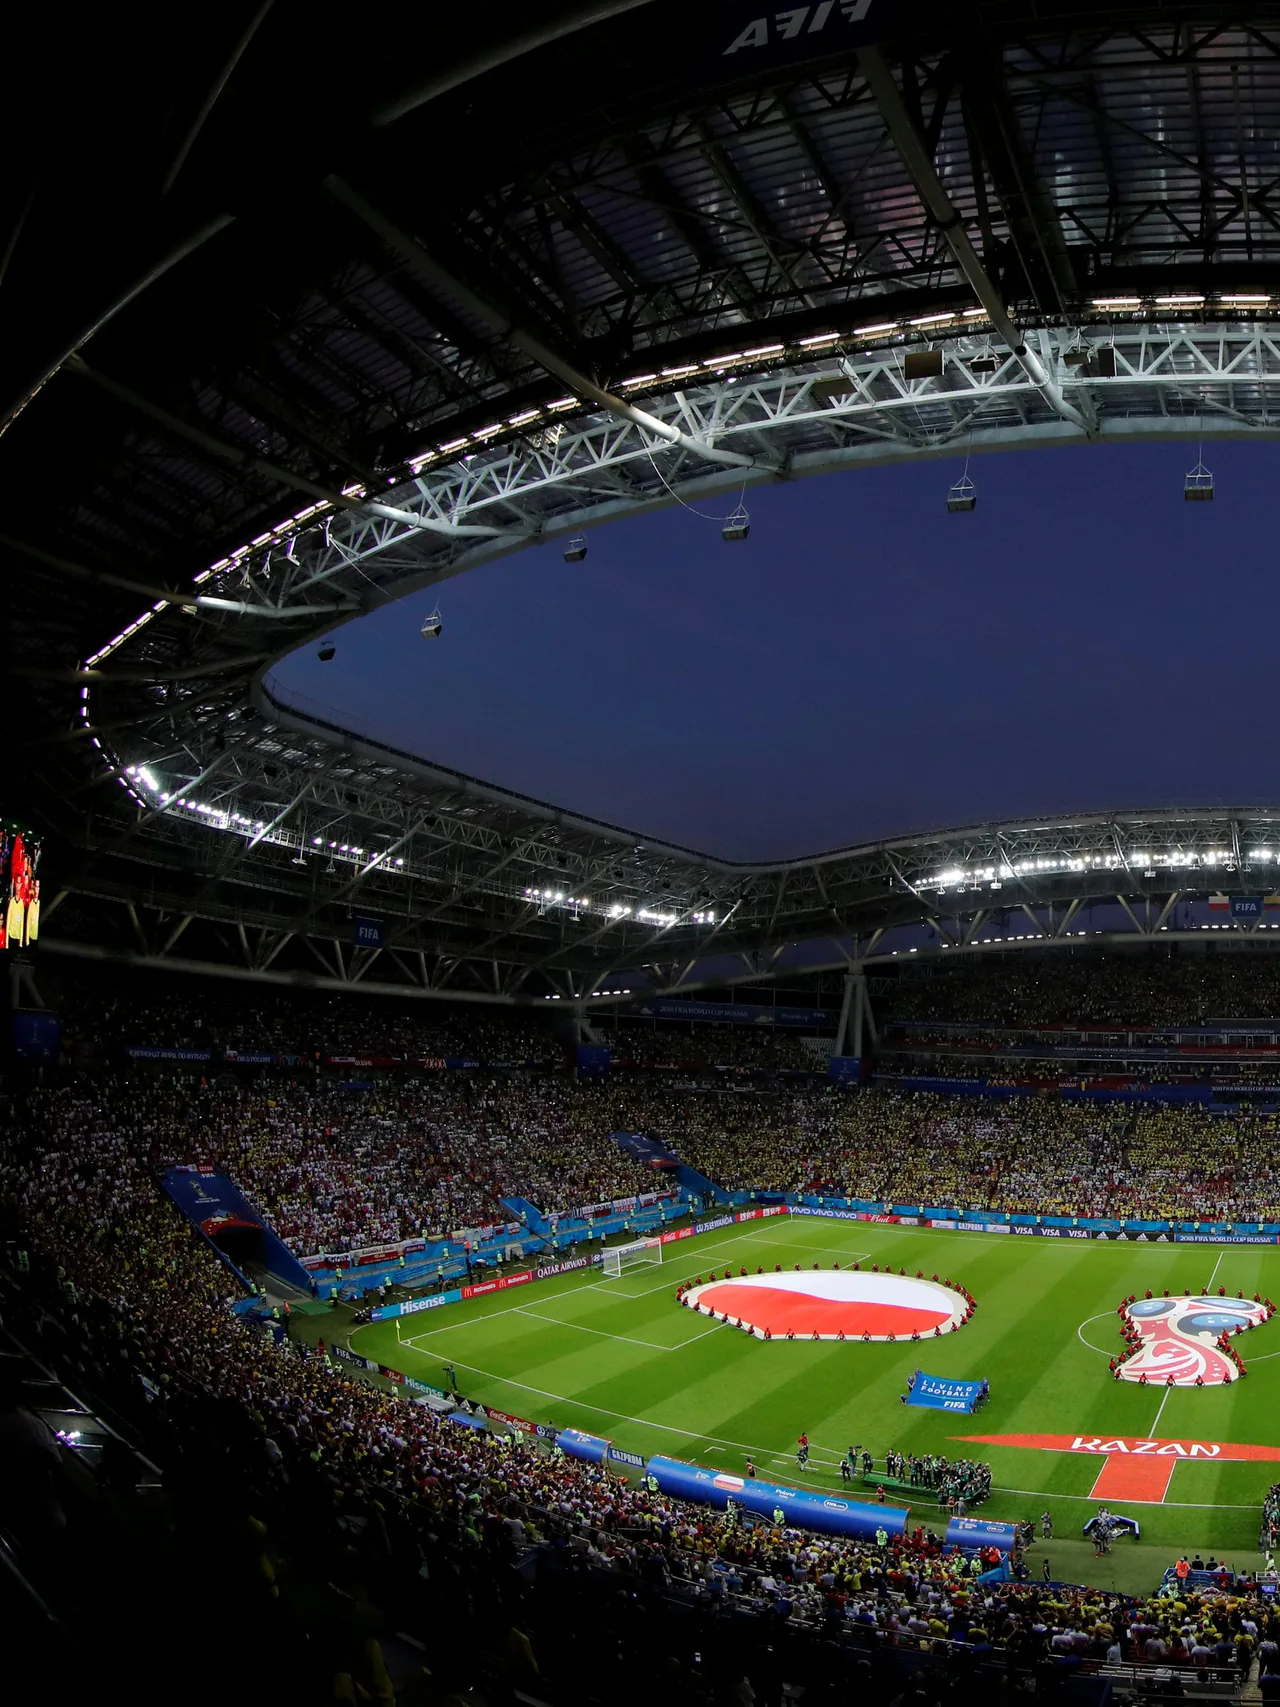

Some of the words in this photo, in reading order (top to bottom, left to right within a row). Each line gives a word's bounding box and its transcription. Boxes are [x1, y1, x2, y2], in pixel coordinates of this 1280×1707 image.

[1235, 903, 1257, 911] FIFA
[359, 926, 379, 940] FIFA
[1014, 1226, 1034, 1235] VISA
[1040, 1228, 1060, 1237] VISA
[1068, 1229, 1088, 1238] VISA
[537, 1262, 560, 1278] QATAR
[560, 1257, 587, 1272] AIRWAYS
[400, 1295, 446, 1315] Hisense
[404, 1376, 444, 1398] Hisense
[920, 1386, 970, 1397] FOOTBALL
[922, 1380, 973, 1392] LIVING
[943, 1401, 966, 1409] FIFA
[1070, 1437, 1221, 1457] KAZAN
[611, 1450, 643, 1468] GAZPROM
[775, 1488, 796, 1498] Poland
